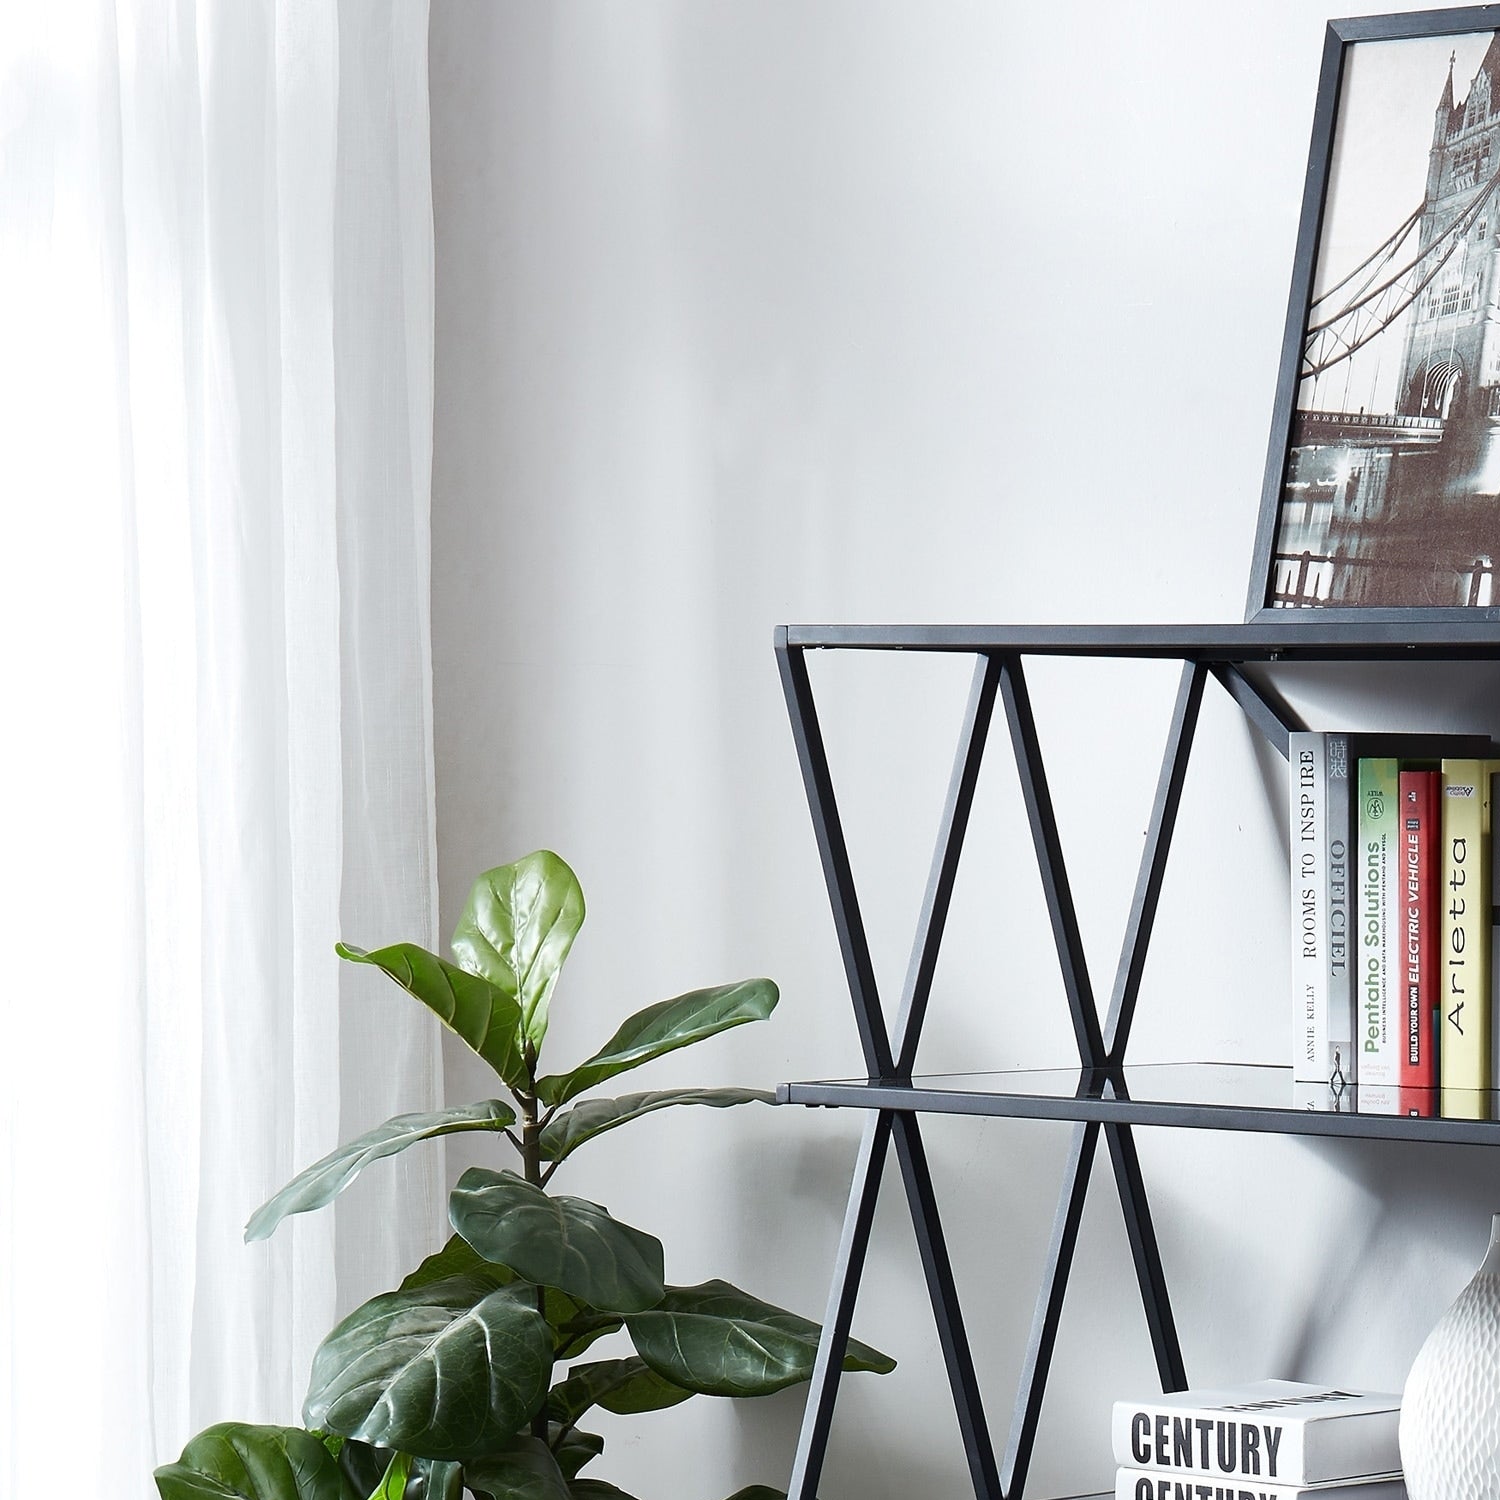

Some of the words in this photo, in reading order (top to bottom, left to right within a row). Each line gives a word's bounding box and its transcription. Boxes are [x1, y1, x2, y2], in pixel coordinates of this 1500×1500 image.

[1299, 750, 1315, 842] INSPIRE
[1301, 853, 1316, 878] TO
[1364, 841, 1380, 947] Solutions
[1408, 833, 1420, 902] VEHICLE
[1302, 888, 1317, 959] ROOMS
[1330, 839, 1346, 977] OFFICIEL
[1448, 838, 1467, 1037] Arletta
[1408, 907, 1420, 983] ELECTRIC
[1306, 984, 1315, 1021] KELLY
[1364, 958, 1380, 1053] Pentaho
[1410, 986, 1419, 1008] OWN
[1410, 1009, 1419, 1036] YOUR
[1307, 1025, 1316, 1062] ANNIE
[1410, 1036, 1419, 1063] BUILD
[1131, 1412, 1283, 1477] CENTURY
